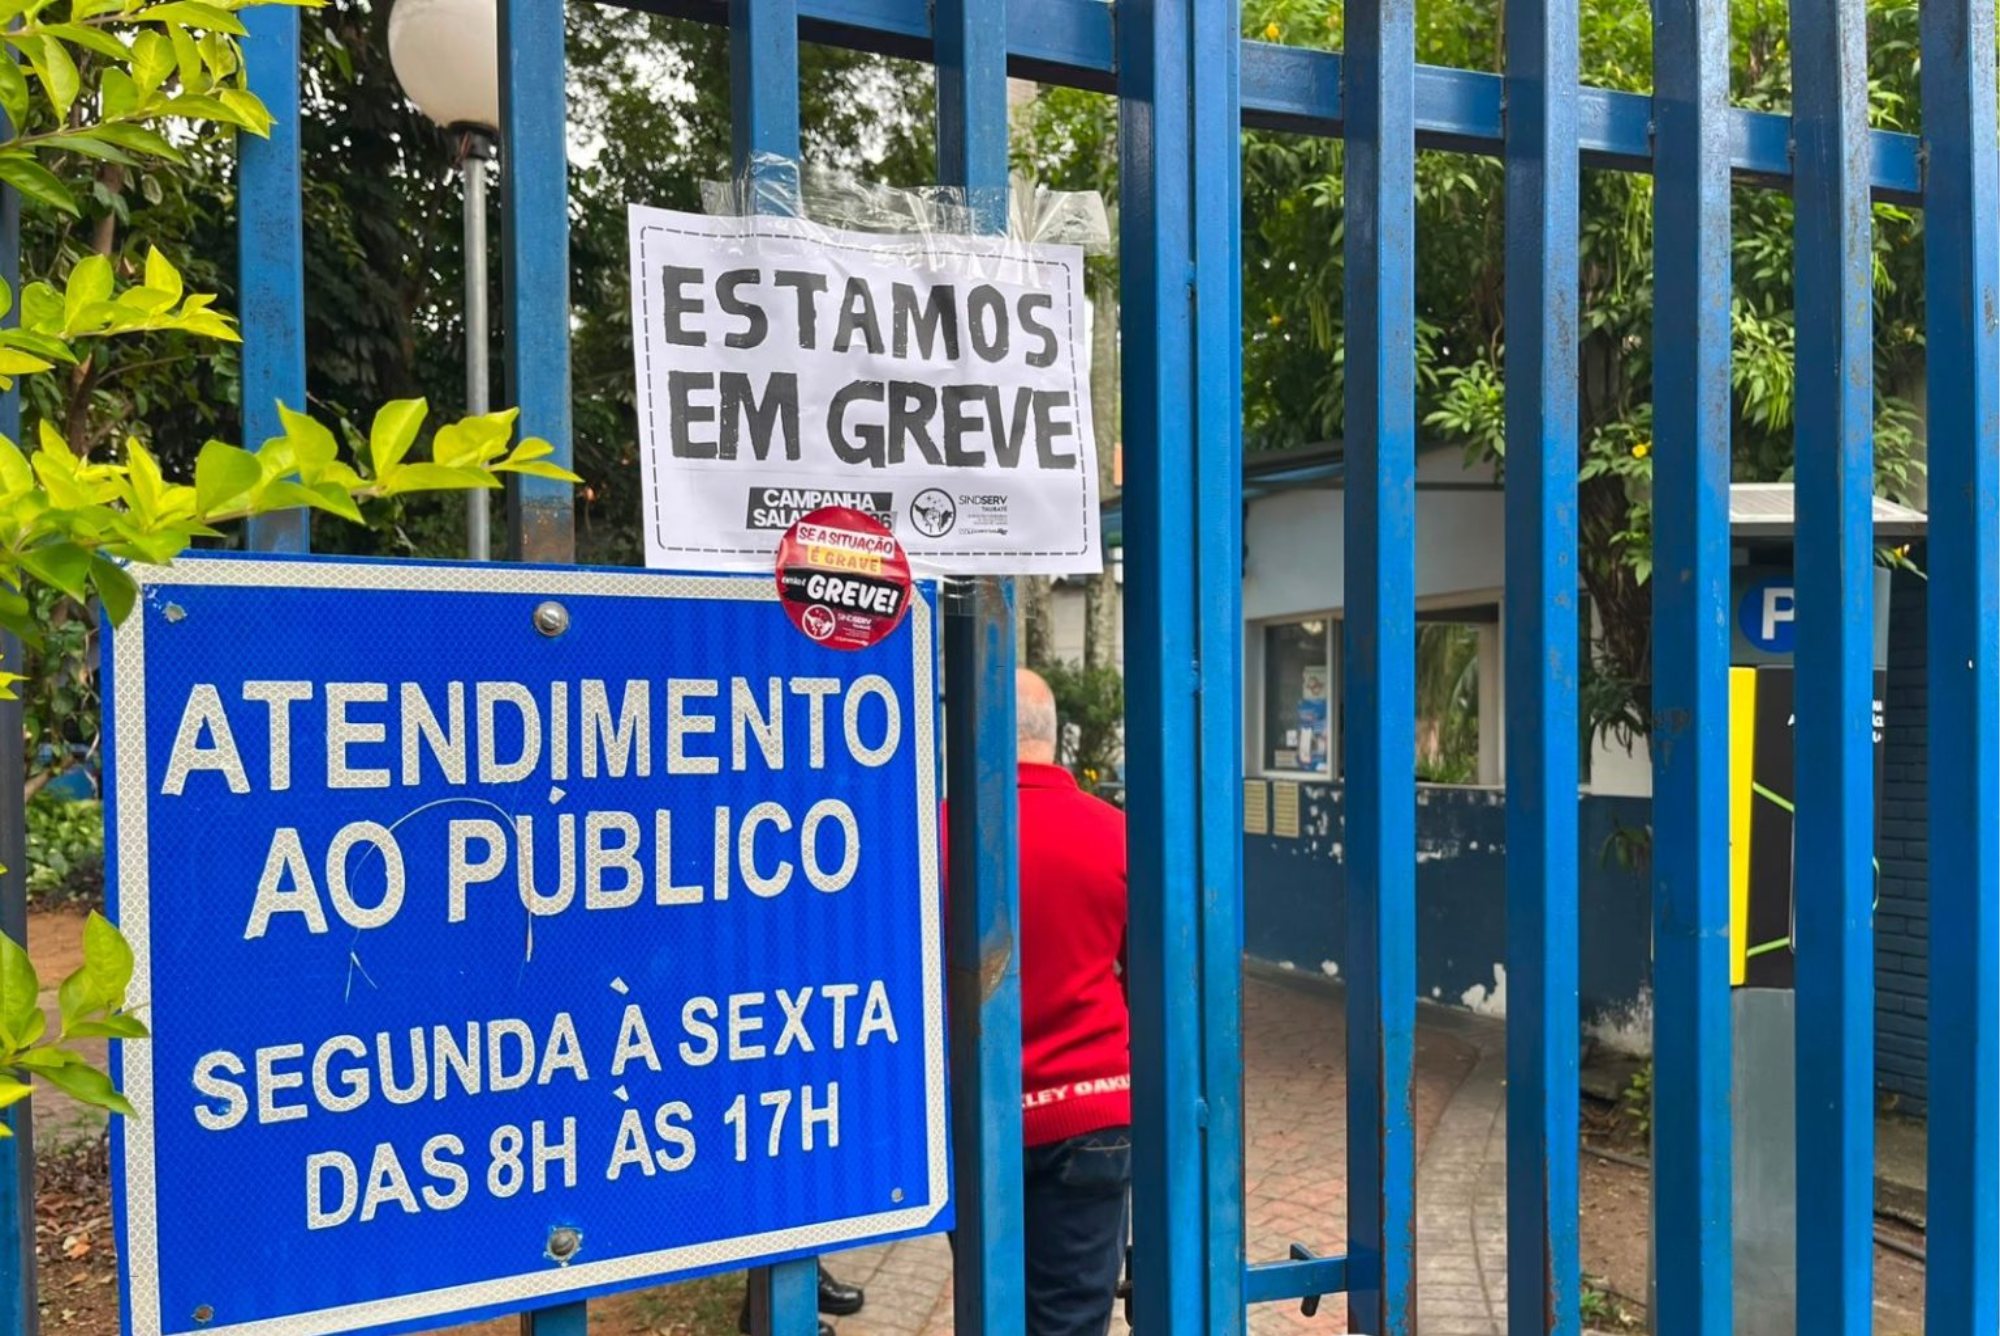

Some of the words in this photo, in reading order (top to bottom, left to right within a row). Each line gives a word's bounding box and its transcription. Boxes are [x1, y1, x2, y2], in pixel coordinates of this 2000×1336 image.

[662, 265, 1058, 368] ESTAMOS
[668, 370, 801, 461] EM
[826, 379, 1077, 469] GREVE
[753, 508, 811, 527] SALA
[763, 489, 876, 511] CAMPANHA
[959, 494, 1007, 505] SINDSERV
[798, 526, 816, 541] SE
[817, 530, 827, 543] A
[828, 531, 893, 555] SITUAÇÃO
[810, 546, 819, 562] É
[825, 551, 879, 572] GRAVE
[807, 574, 898, 614] GREVE!
[1762, 588, 1794, 639] P
[161, 674, 902, 796] ATENDIMENTO
[243, 820, 405, 940] AO
[448, 786, 861, 922] PÚBLICO
[193, 1012, 589, 1131] SEGUNDA
[609, 977, 662, 1077] À
[679, 979, 899, 1067] SEXTA
[1022, 1085, 1068, 1108] LEY
[306, 1133, 470, 1230] DAS
[488, 1117, 578, 1199] 8H
[605, 1086, 697, 1180] ÀS
[724, 1082, 841, 1162] 17H
